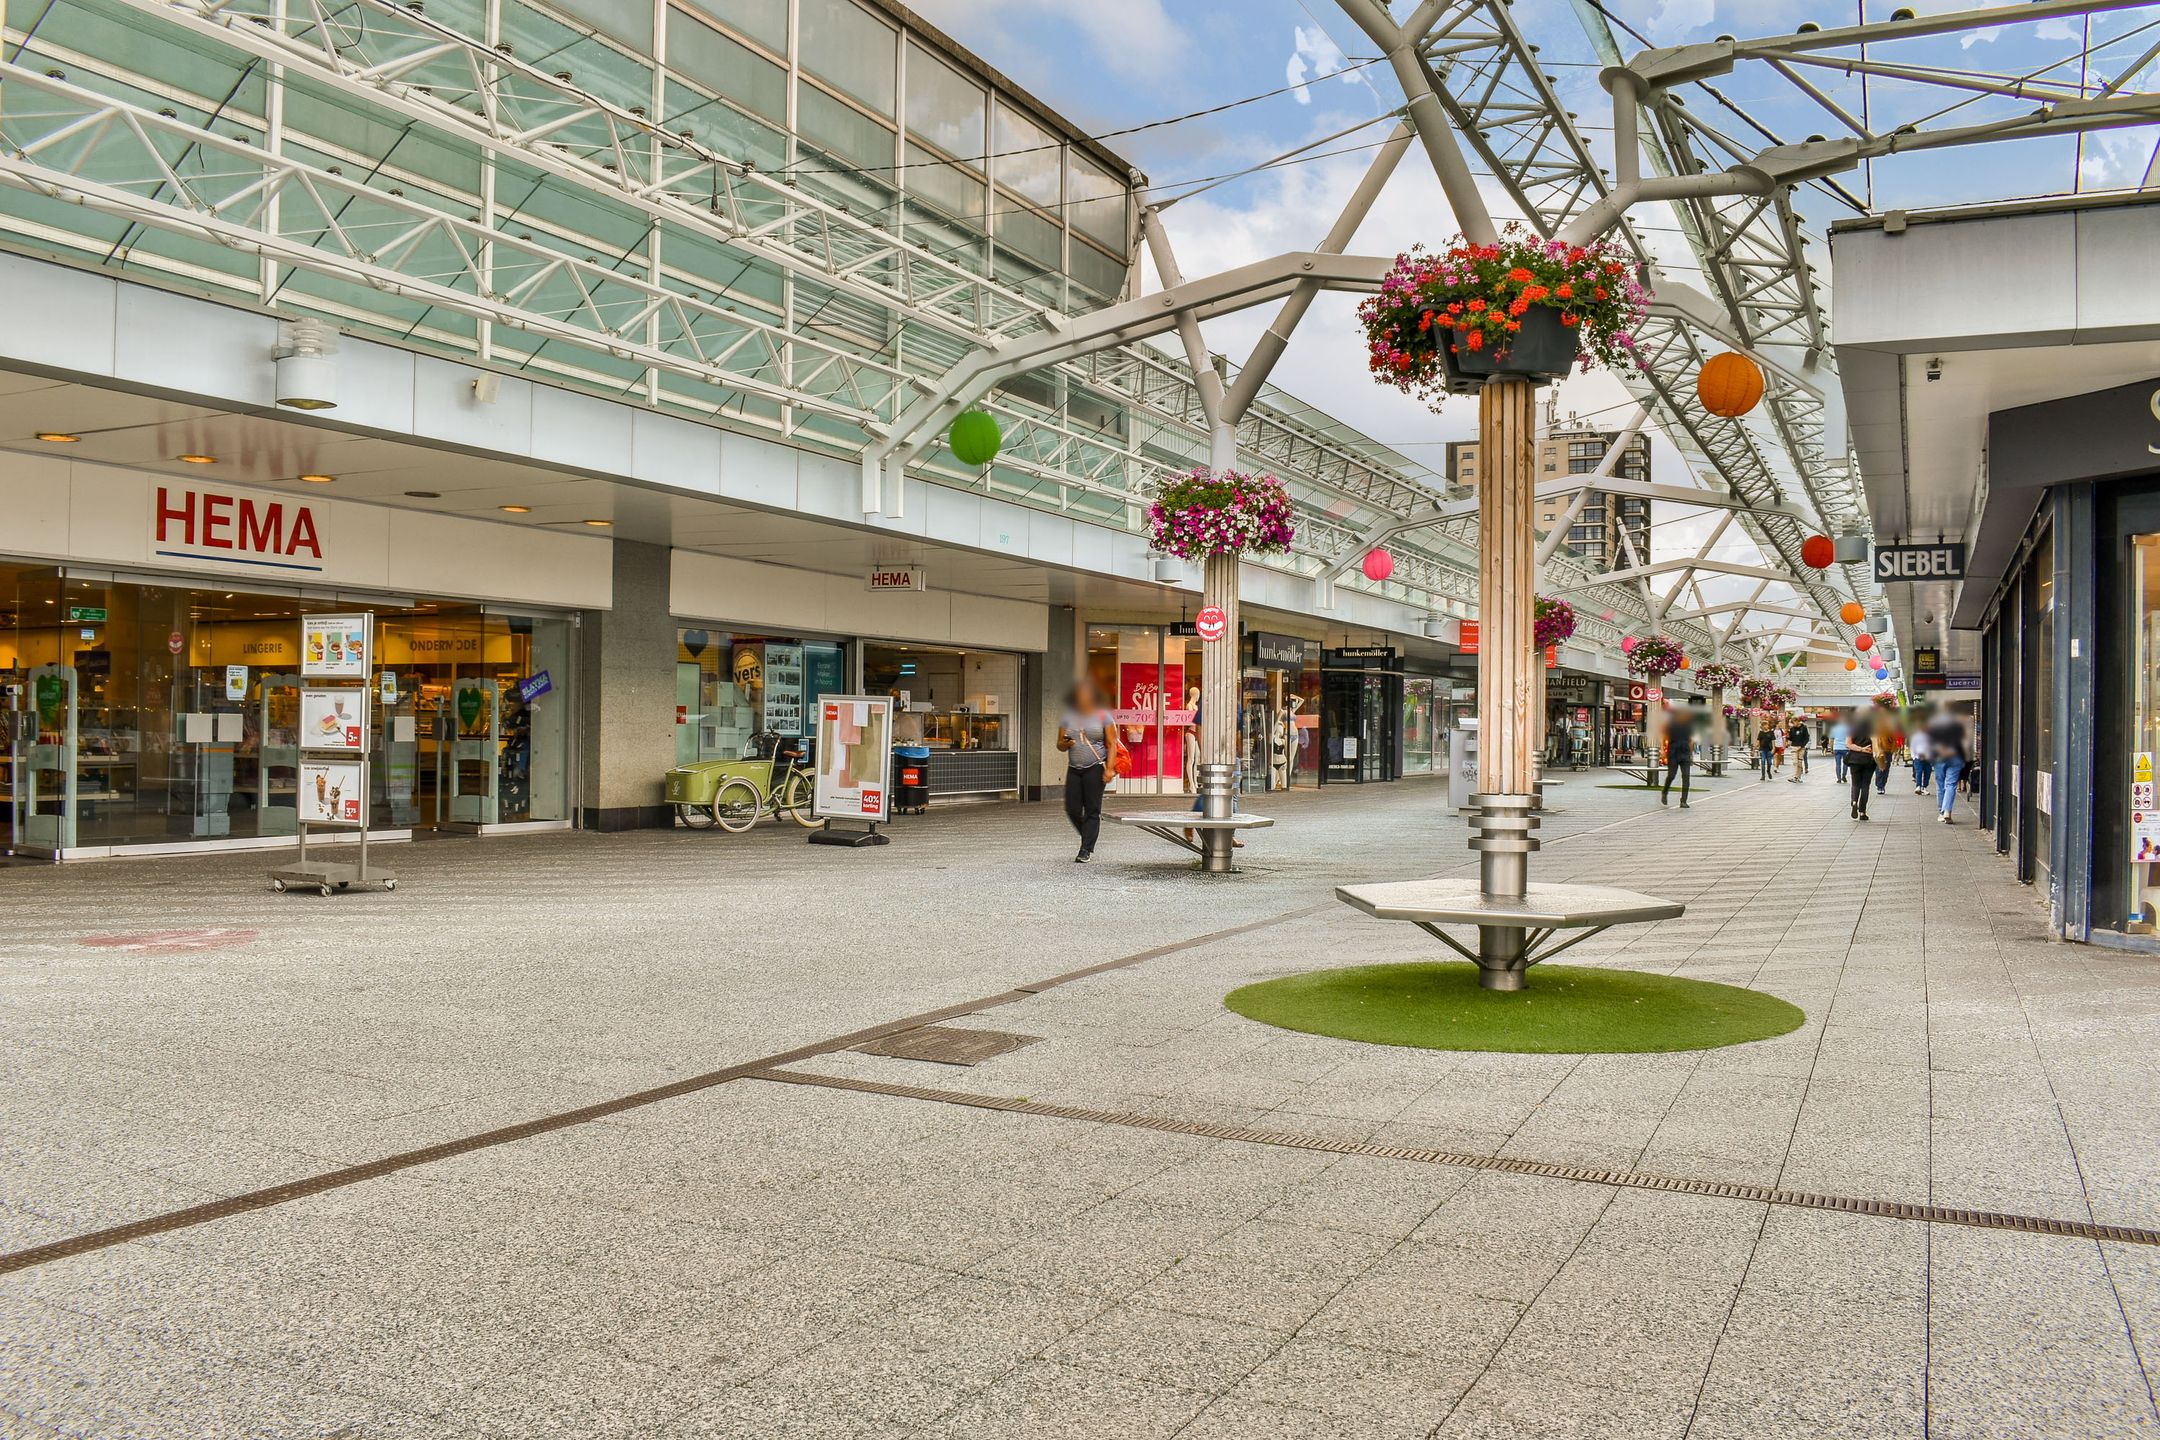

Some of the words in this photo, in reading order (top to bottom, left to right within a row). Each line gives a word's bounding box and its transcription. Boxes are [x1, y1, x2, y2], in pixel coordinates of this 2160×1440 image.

[156, 486, 323, 559] HEMA
[1878, 549, 1961, 577] SIEBEL
[871, 572, 911, 586] HEMA
[242, 643, 283, 655] LINGERIE
[1259, 639, 1303, 664] hunkemöller
[1342, 649, 1388, 657] hunkemöller
[734, 665, 761, 683] vers
[863, 794, 880, 804] 40%
